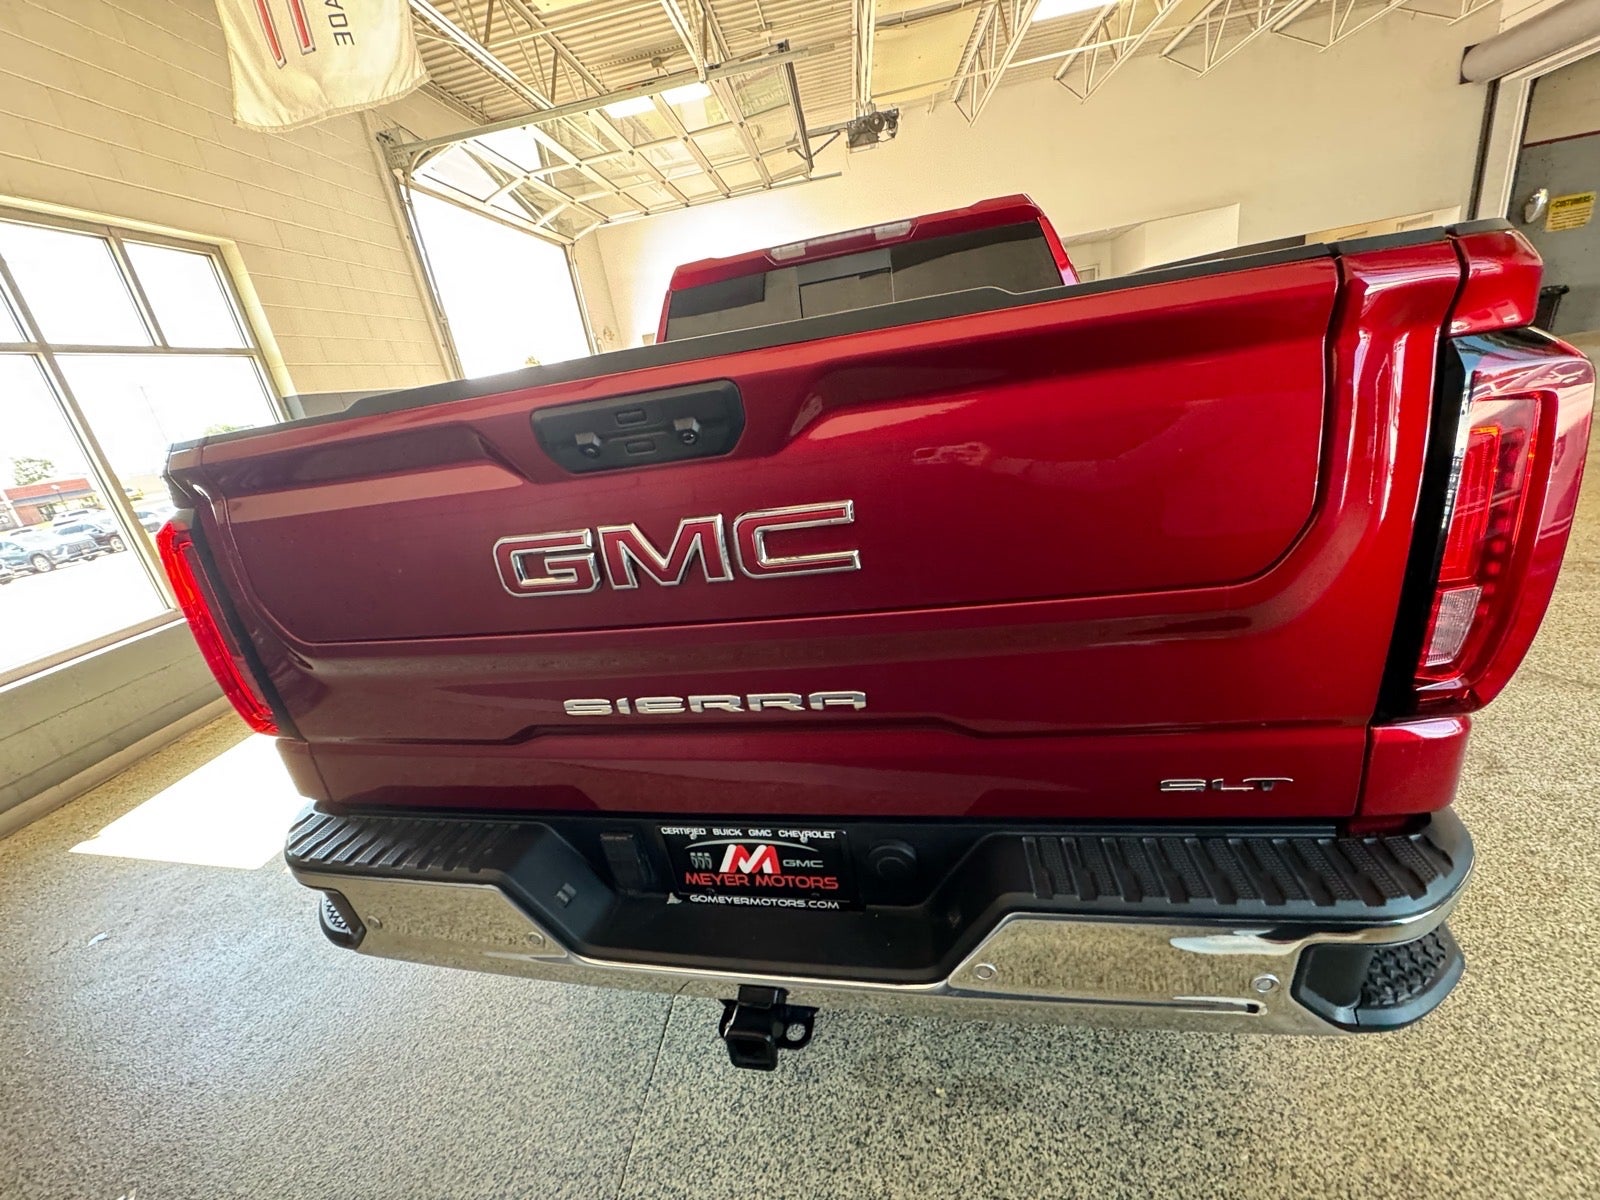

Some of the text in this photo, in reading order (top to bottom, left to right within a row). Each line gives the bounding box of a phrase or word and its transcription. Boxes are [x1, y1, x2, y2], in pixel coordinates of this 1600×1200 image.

[493, 499, 862, 597] GMC
[563, 690, 867, 716] SIERRA
[1160, 777, 1294, 792] SLT
[660, 827, 836, 839] CERTIFIED BUICK GMC CHEVROLET
[782, 859, 824, 868] GMC
[685, 872, 839, 890] MEYER MOTORS
[689, 894, 840, 910] GOMEYERMOTORS.COM
